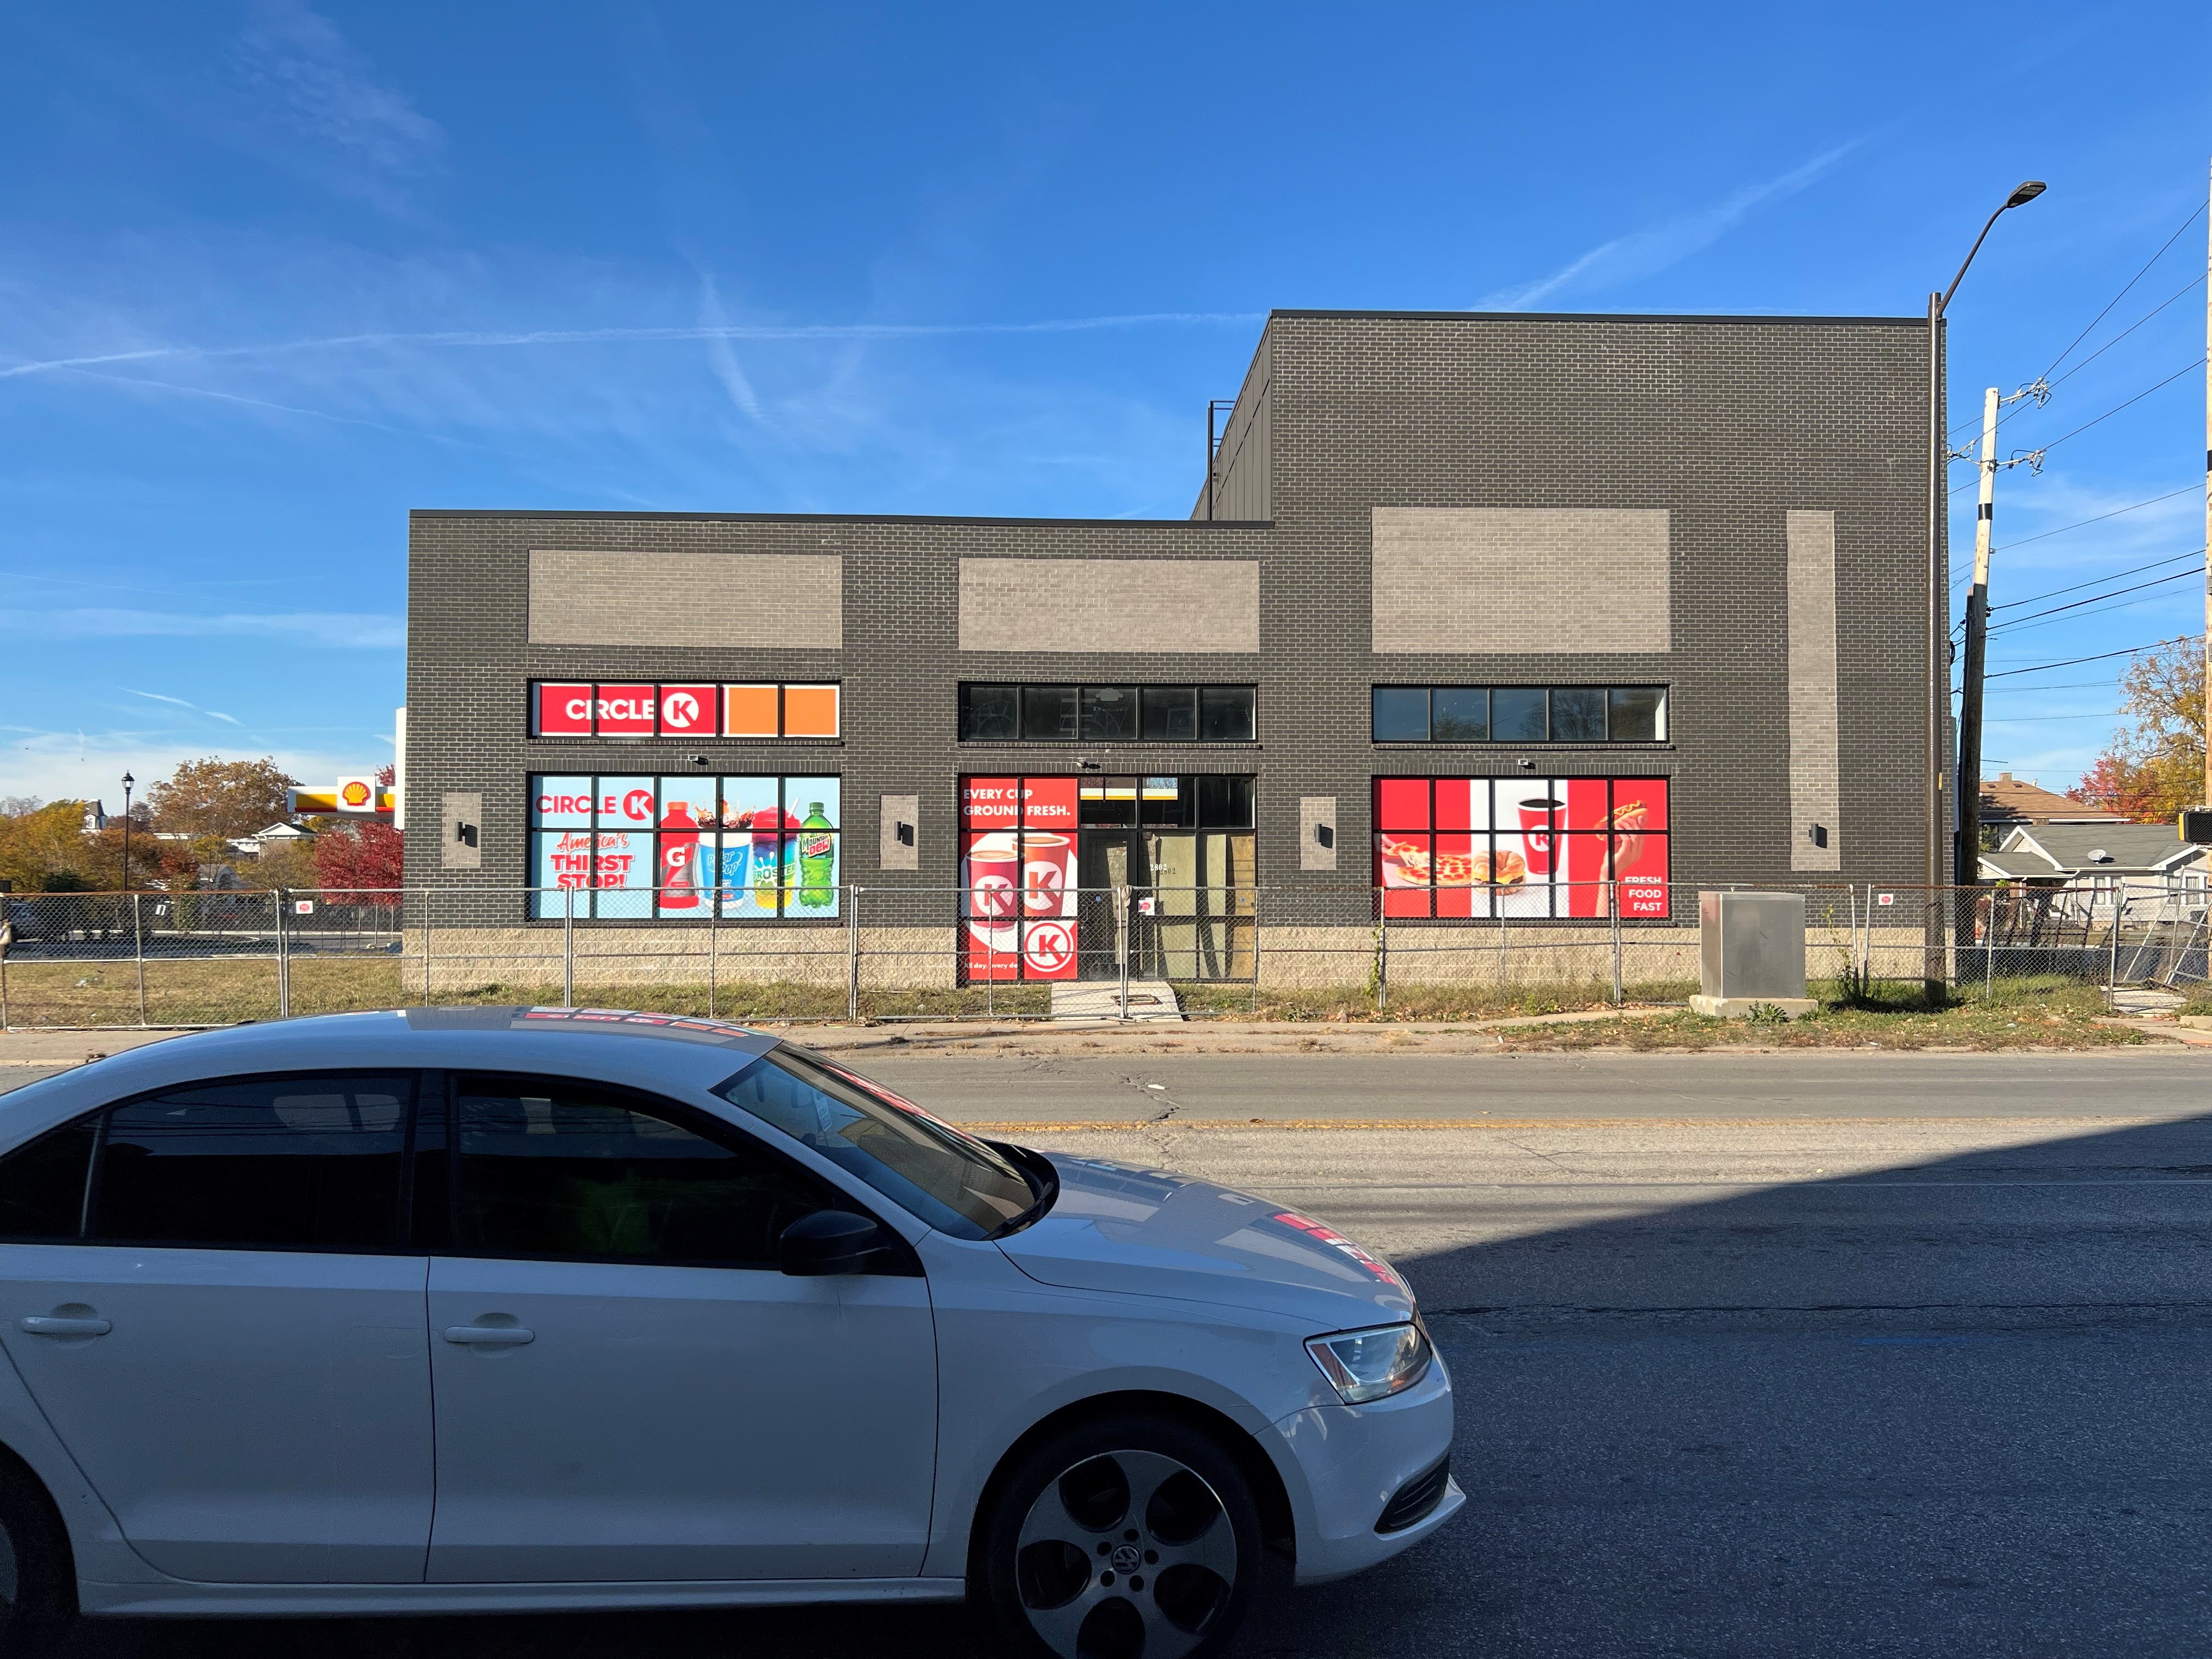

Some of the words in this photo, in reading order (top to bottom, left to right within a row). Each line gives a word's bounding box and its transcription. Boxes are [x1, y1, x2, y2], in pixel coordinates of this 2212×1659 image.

[566, 699, 654, 720] CIRCLE
[963, 789, 1003, 799] EVERY
[1006, 789, 1033, 800] CUP
[535, 795, 617, 814] CIRCLE
[963, 805, 1024, 816] GROUND
[1027, 805, 1070, 816] FRESH.
[550, 855, 633, 871] THIRST
[667, 847, 685, 867] G
[707, 851, 735, 866] Plar
[557, 873, 625, 888] STOP!
[1628, 889, 1662, 898] FOOD
[1633, 902, 1662, 911] FAST
